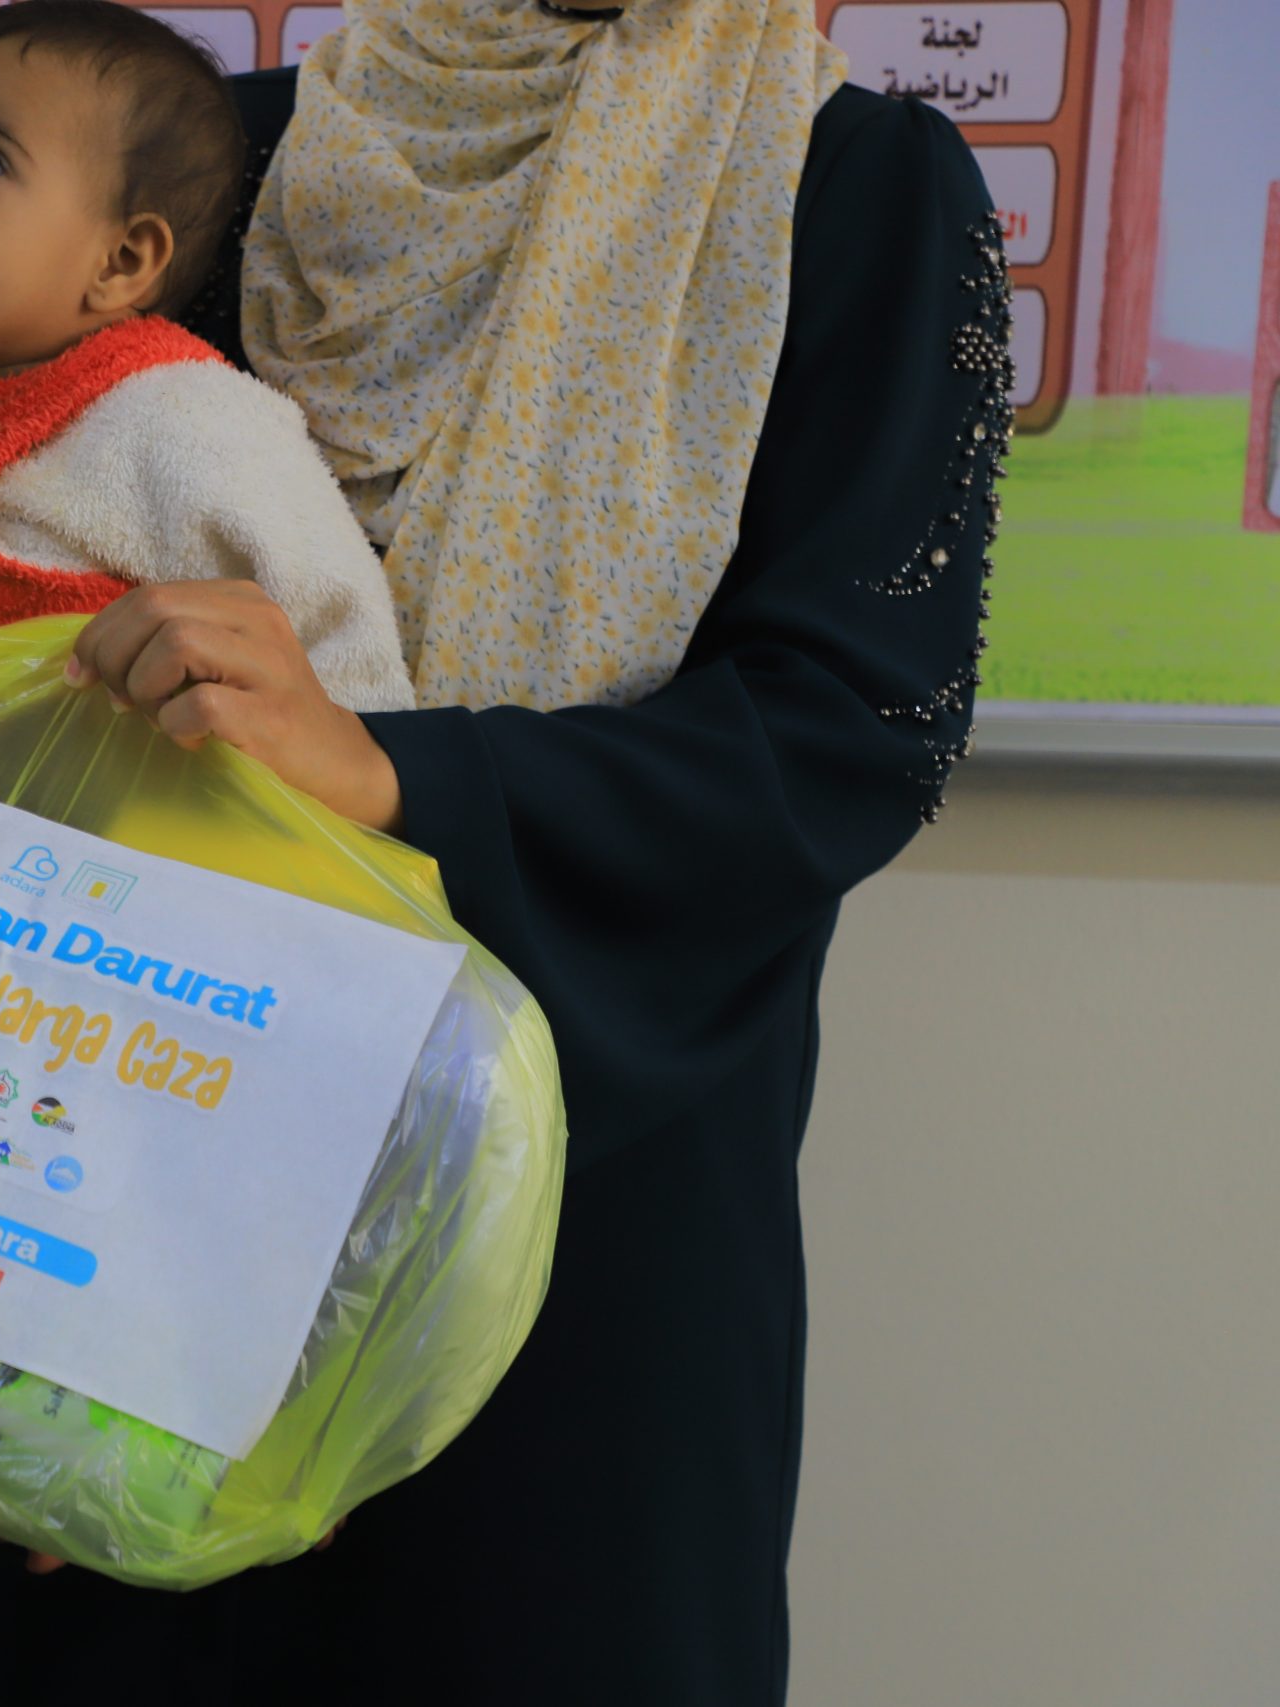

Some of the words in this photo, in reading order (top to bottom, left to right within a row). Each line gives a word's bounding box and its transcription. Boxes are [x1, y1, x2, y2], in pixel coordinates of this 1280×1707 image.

[921, 16, 982, 57] لجنة
[0, 872, 46, 898] adara
[51, 922, 277, 1030] Darurat
